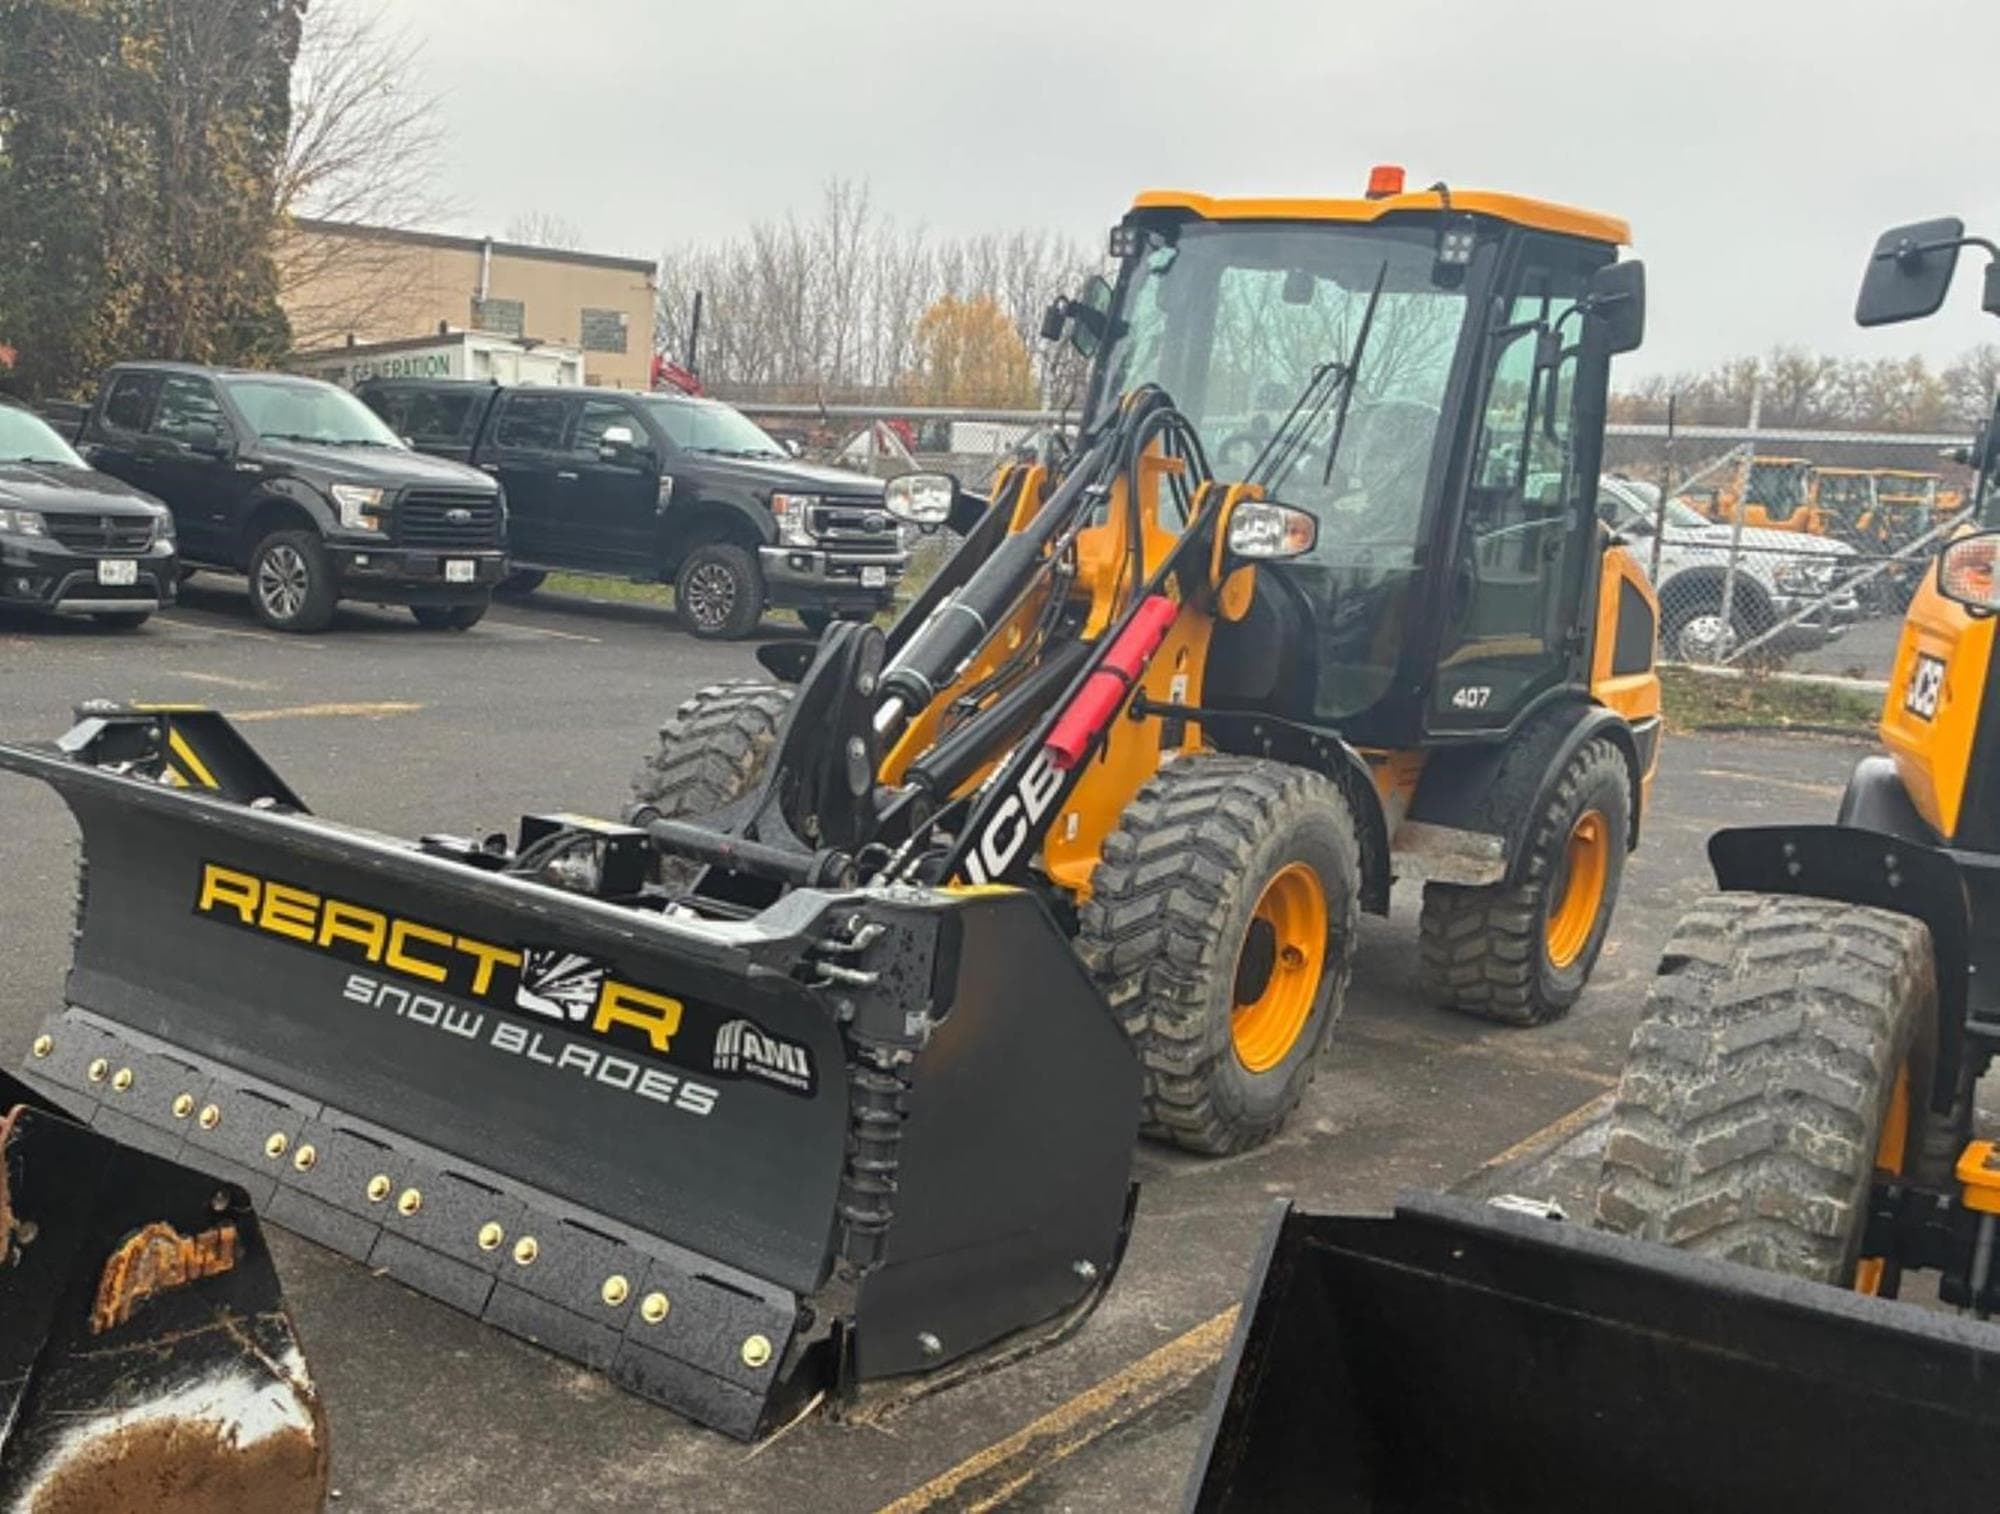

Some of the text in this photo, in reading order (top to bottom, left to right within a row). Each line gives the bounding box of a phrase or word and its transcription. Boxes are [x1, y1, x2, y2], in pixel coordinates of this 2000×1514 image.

[1452, 686, 1491, 709] 407
[200, 863, 684, 1053] REACTR
[343, 974, 720, 1116] SNOW BLADES
